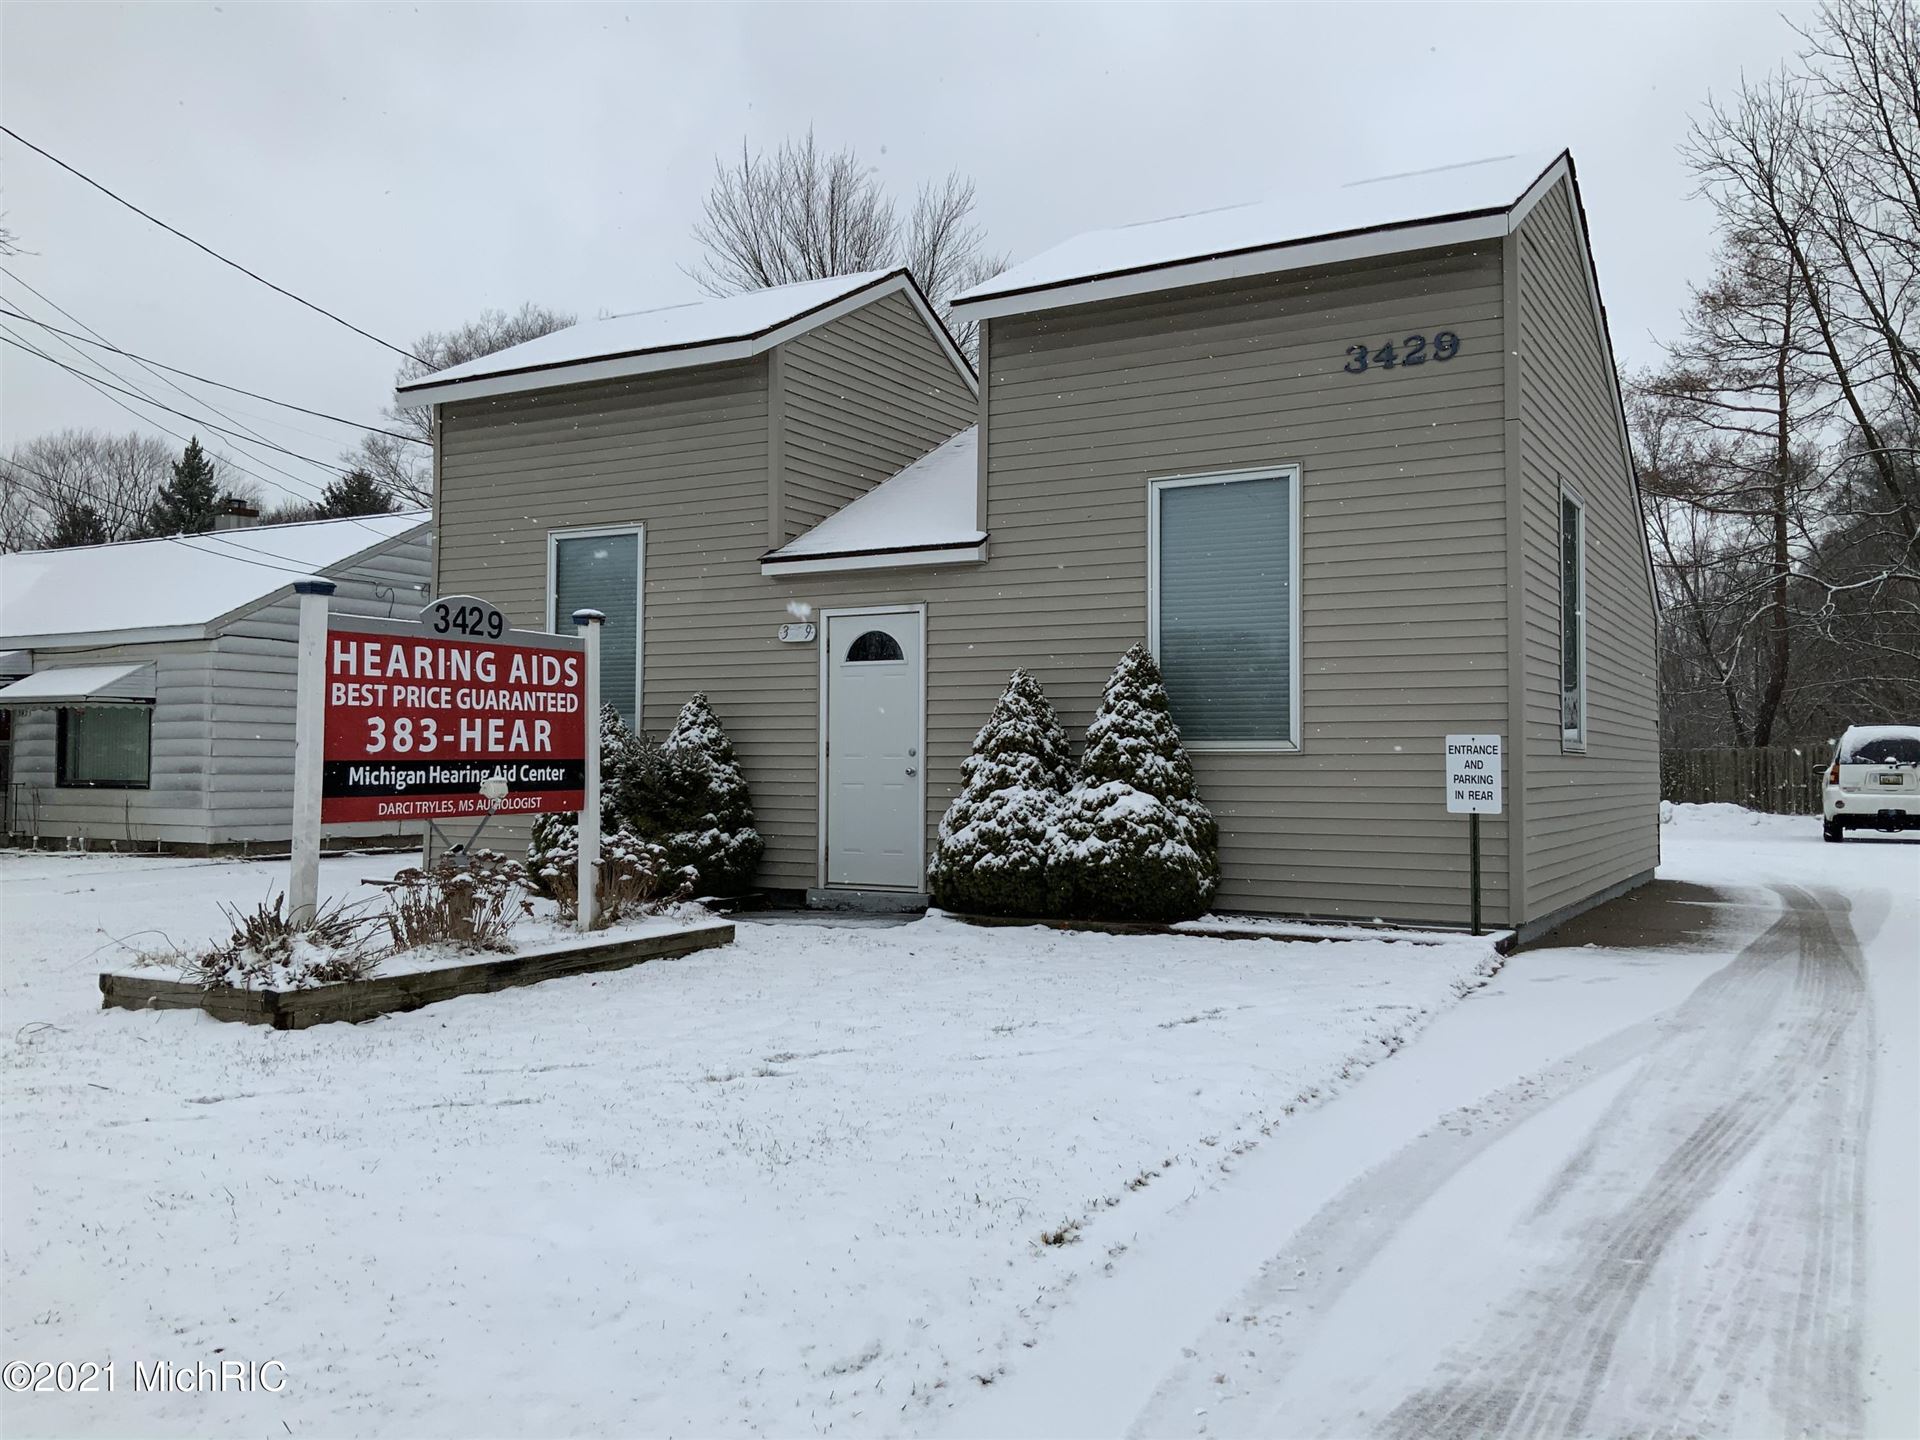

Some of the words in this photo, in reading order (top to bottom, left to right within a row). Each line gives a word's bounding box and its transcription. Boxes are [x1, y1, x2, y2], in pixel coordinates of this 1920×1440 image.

[1344, 331, 1460, 374] 3429
[433, 603, 504, 639] 3429
[332, 640, 497, 683] HEARING
[508, 653, 579, 687] AIDS
[331, 682, 388, 707] BEST
[392, 684, 452, 709] PRICE
[456, 688, 579, 713] GUARANTEED
[365, 716, 552, 753] 383-HEAR
[1448, 744, 1499, 755] ENTRANCE
[348, 766, 426, 790] Michigan
[429, 764, 490, 787] Hearing
[491, 764, 517, 782] Aid
[520, 764, 566, 782] Center
[1464, 760, 1484, 770] AND
[1453, 774, 1494, 785] PARKING
[378, 802, 414, 816] DARCI
[415, 799, 457, 814] TRYLES,
[458, 799, 474, 812] MS
[1454, 790, 1464, 800] IN
[1468, 790, 1494, 801] REAR
